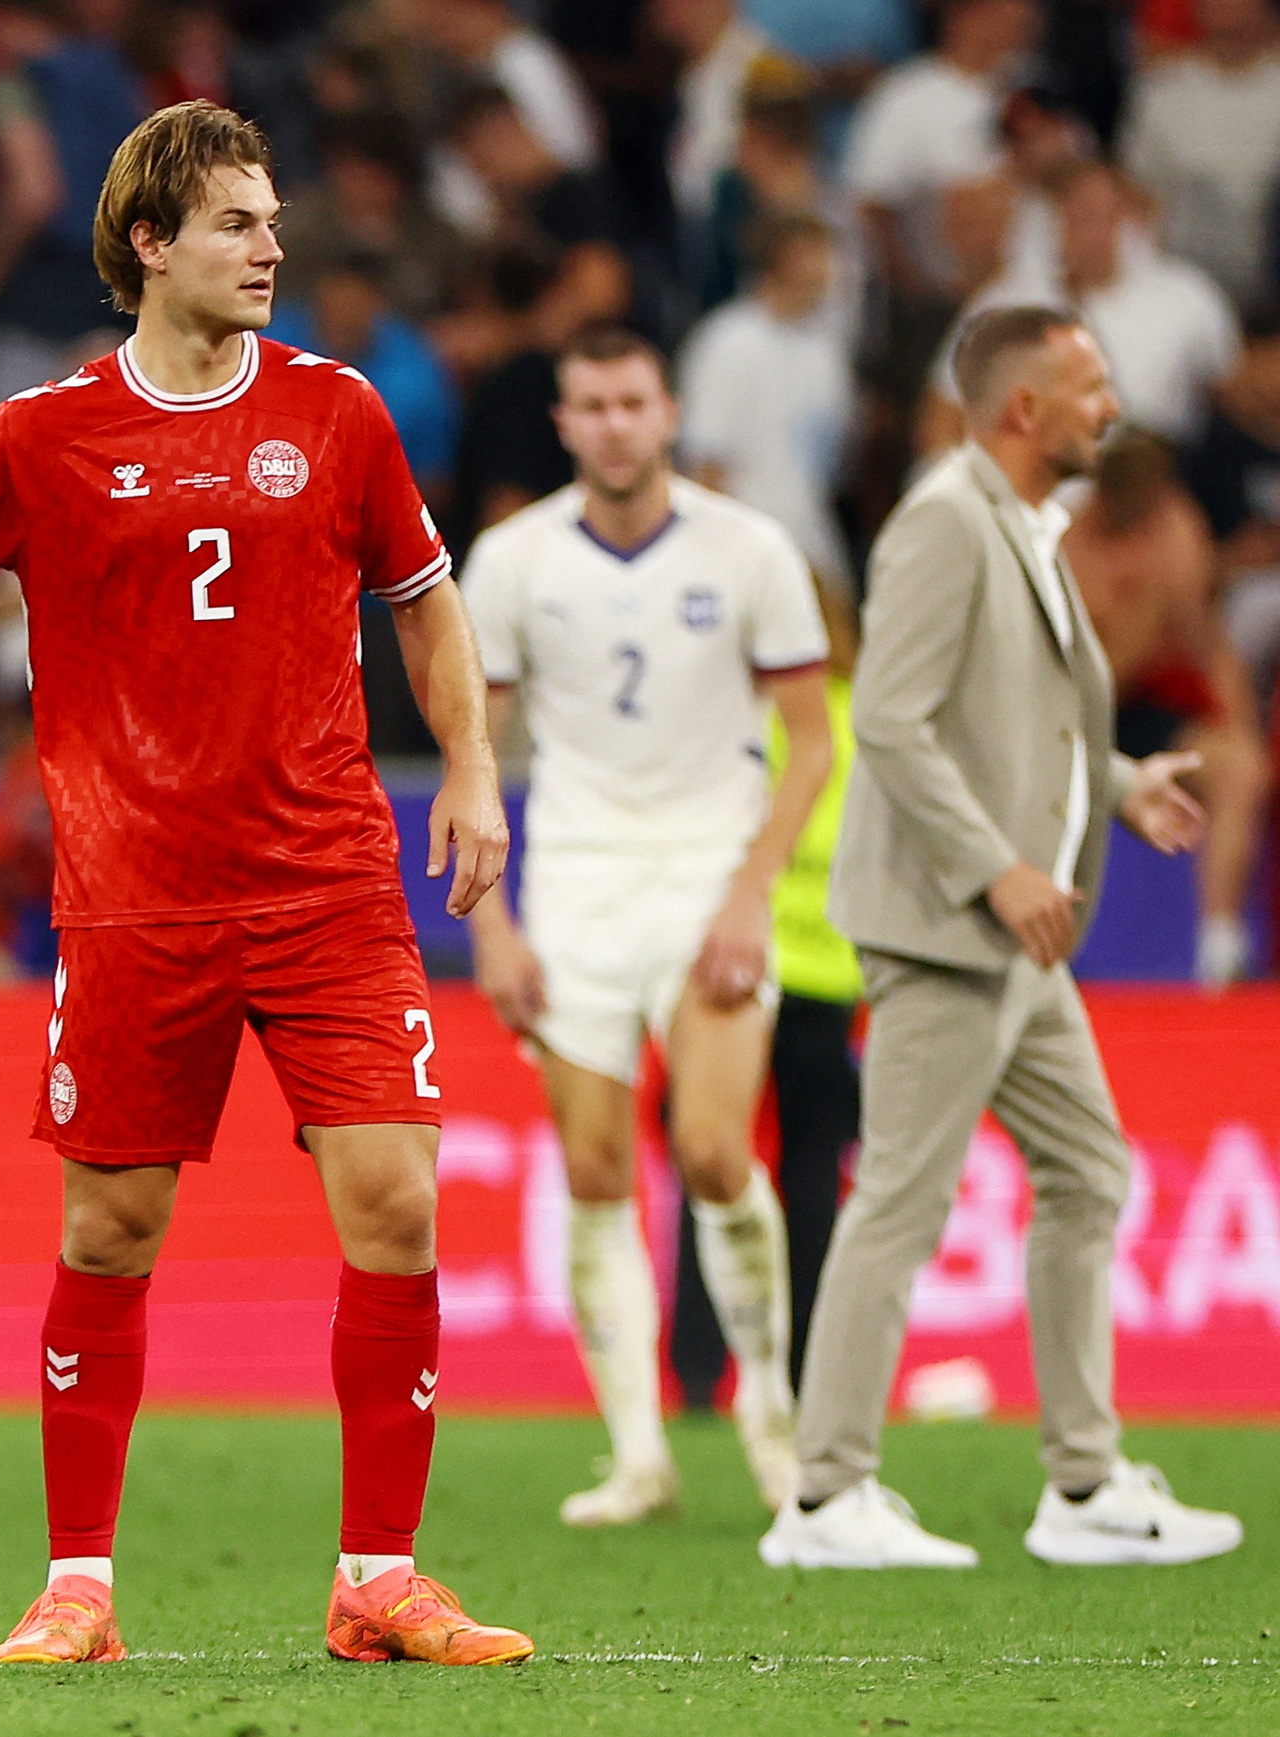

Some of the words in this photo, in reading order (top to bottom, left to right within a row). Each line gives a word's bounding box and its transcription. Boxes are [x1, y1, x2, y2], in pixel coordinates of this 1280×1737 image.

[260, 459, 297, 476] DBU
[188, 528, 235, 620] 2
[612, 643, 647, 718] 2
[404, 1009, 441, 1099] 2
